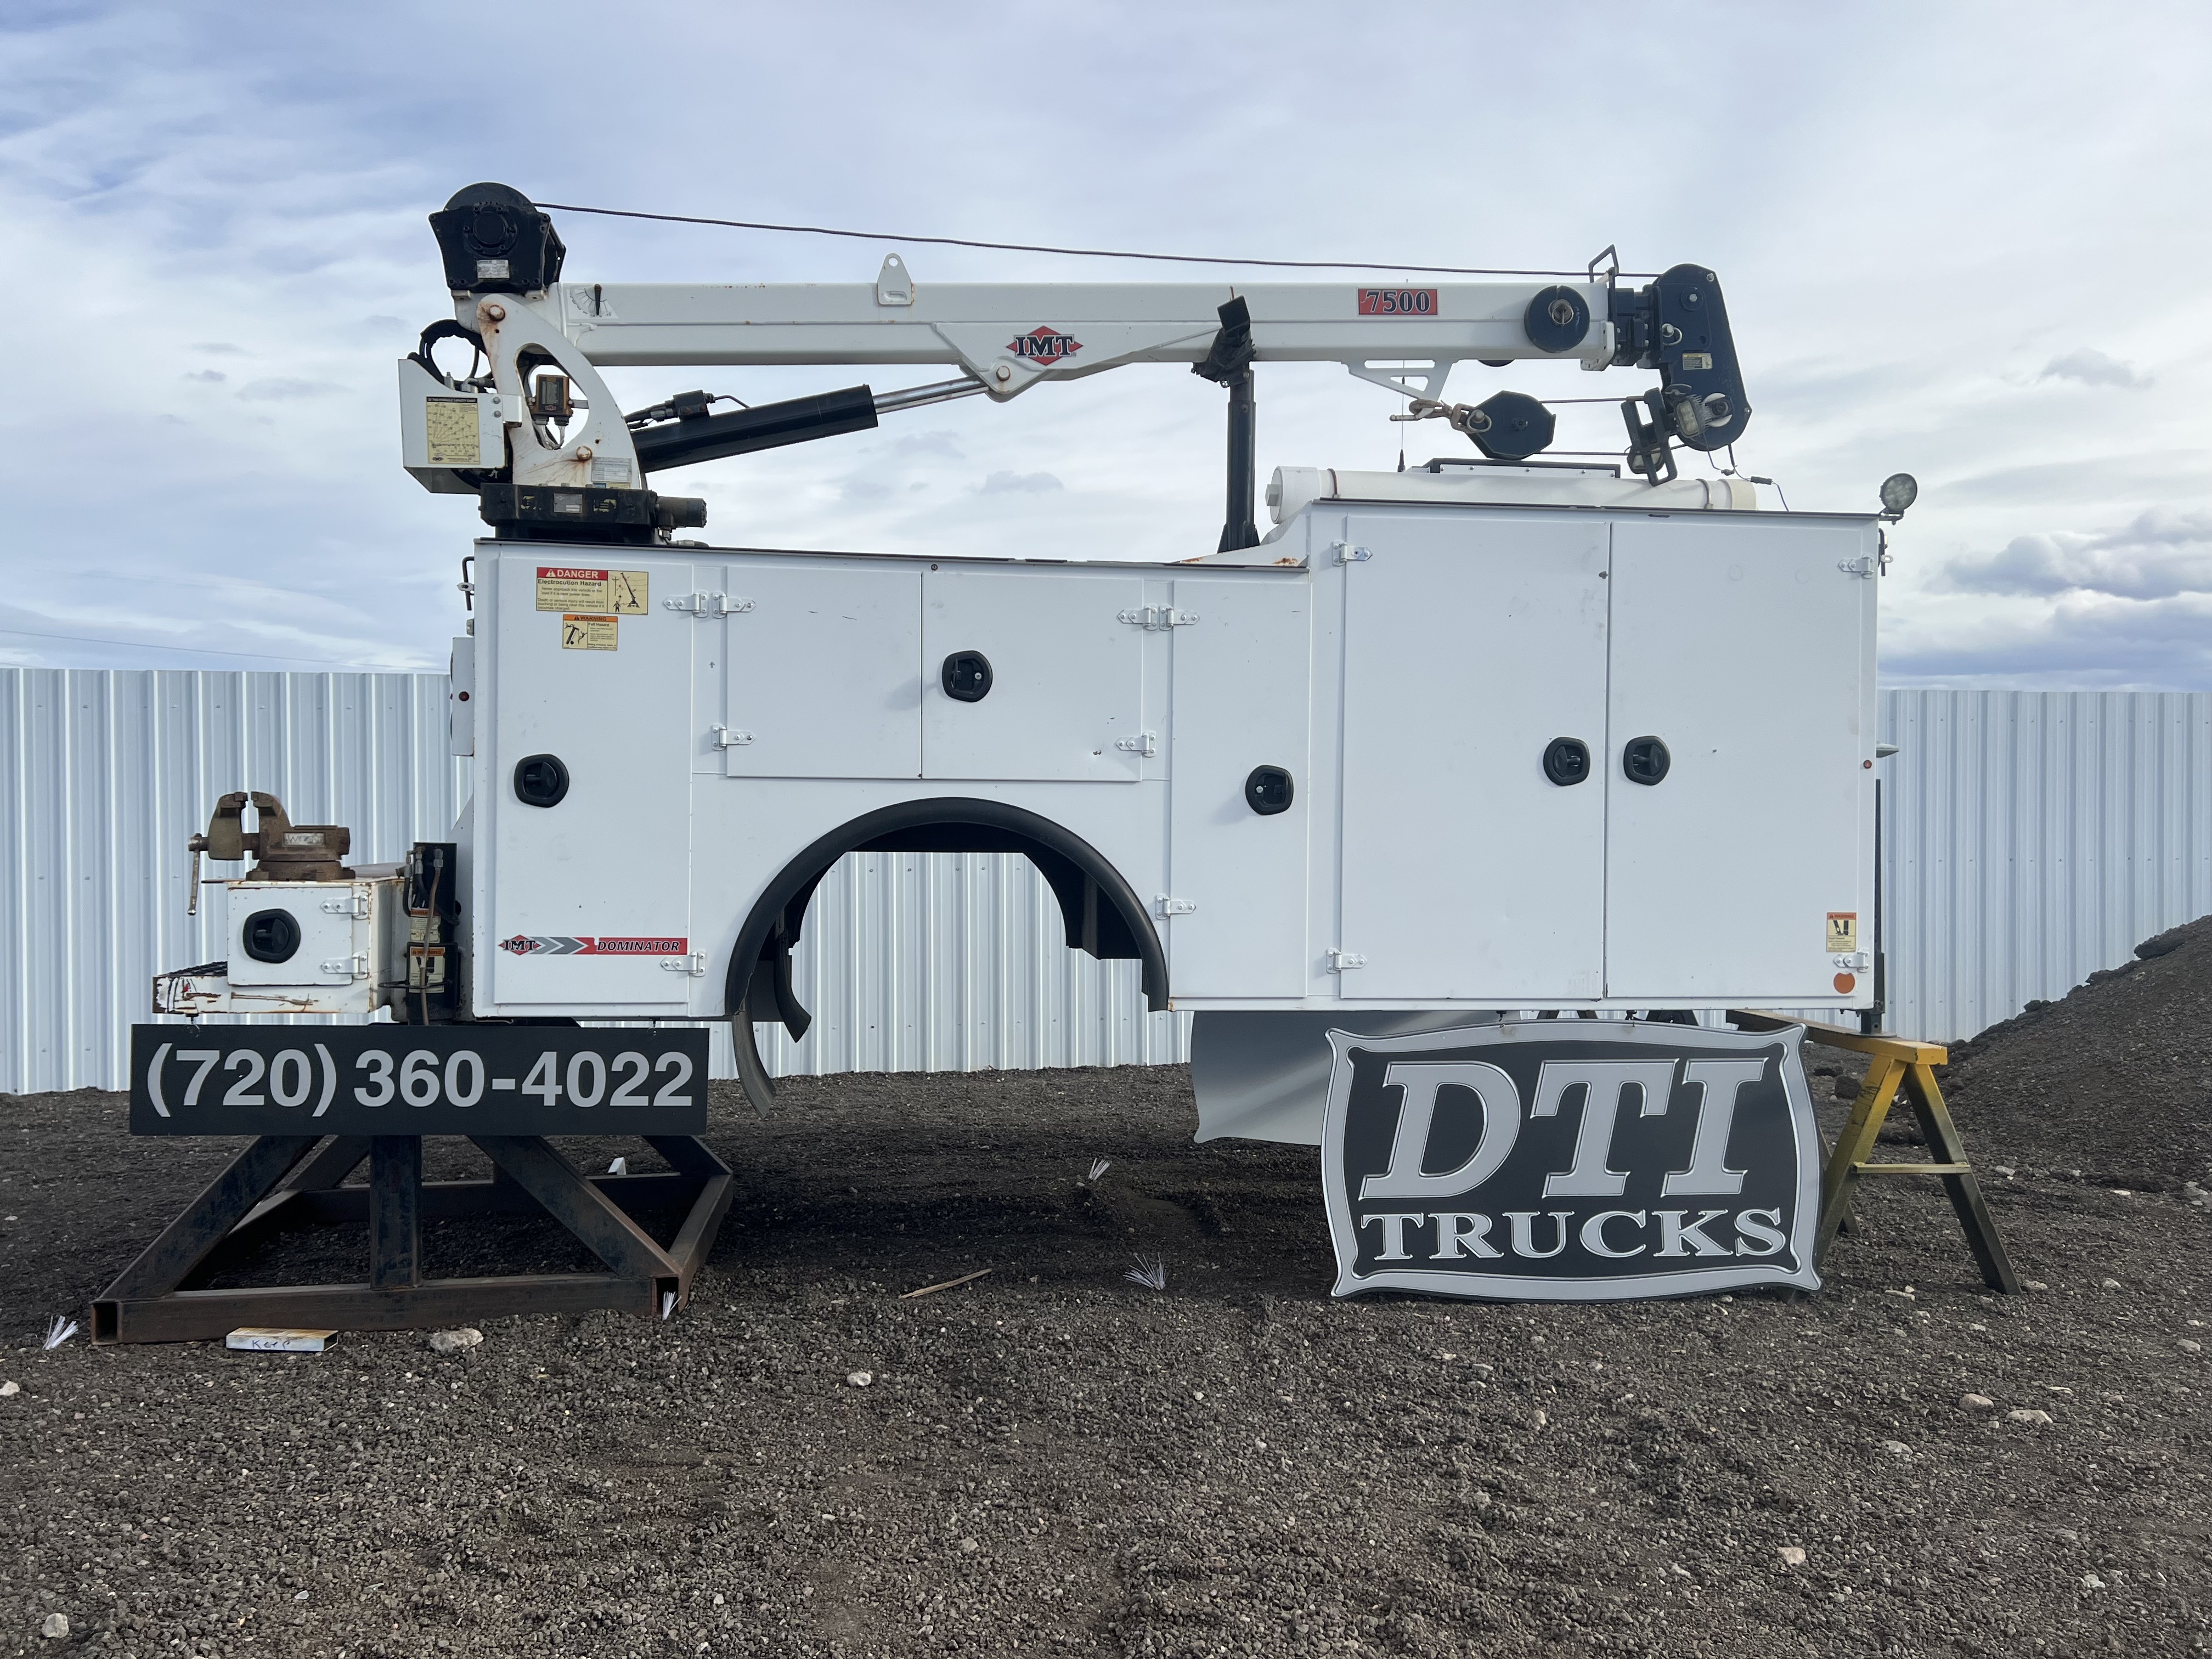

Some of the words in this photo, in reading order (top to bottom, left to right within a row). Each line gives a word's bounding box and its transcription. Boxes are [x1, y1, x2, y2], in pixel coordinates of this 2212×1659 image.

[1366, 290, 1431, 313] 7500
[1014, 335, 1074, 357] IMT
[557, 569, 599, 578] DANGER
[504, 940, 536, 951] IMT
[597, 941, 680, 951] DOMINATOR
[147, 1043, 337, 1117] (720)
[353, 1049, 693, 1107] 360-4022
[1358, 1057, 1770, 1201] DTI
[1360, 1207, 1787, 1260] TRUCKS
